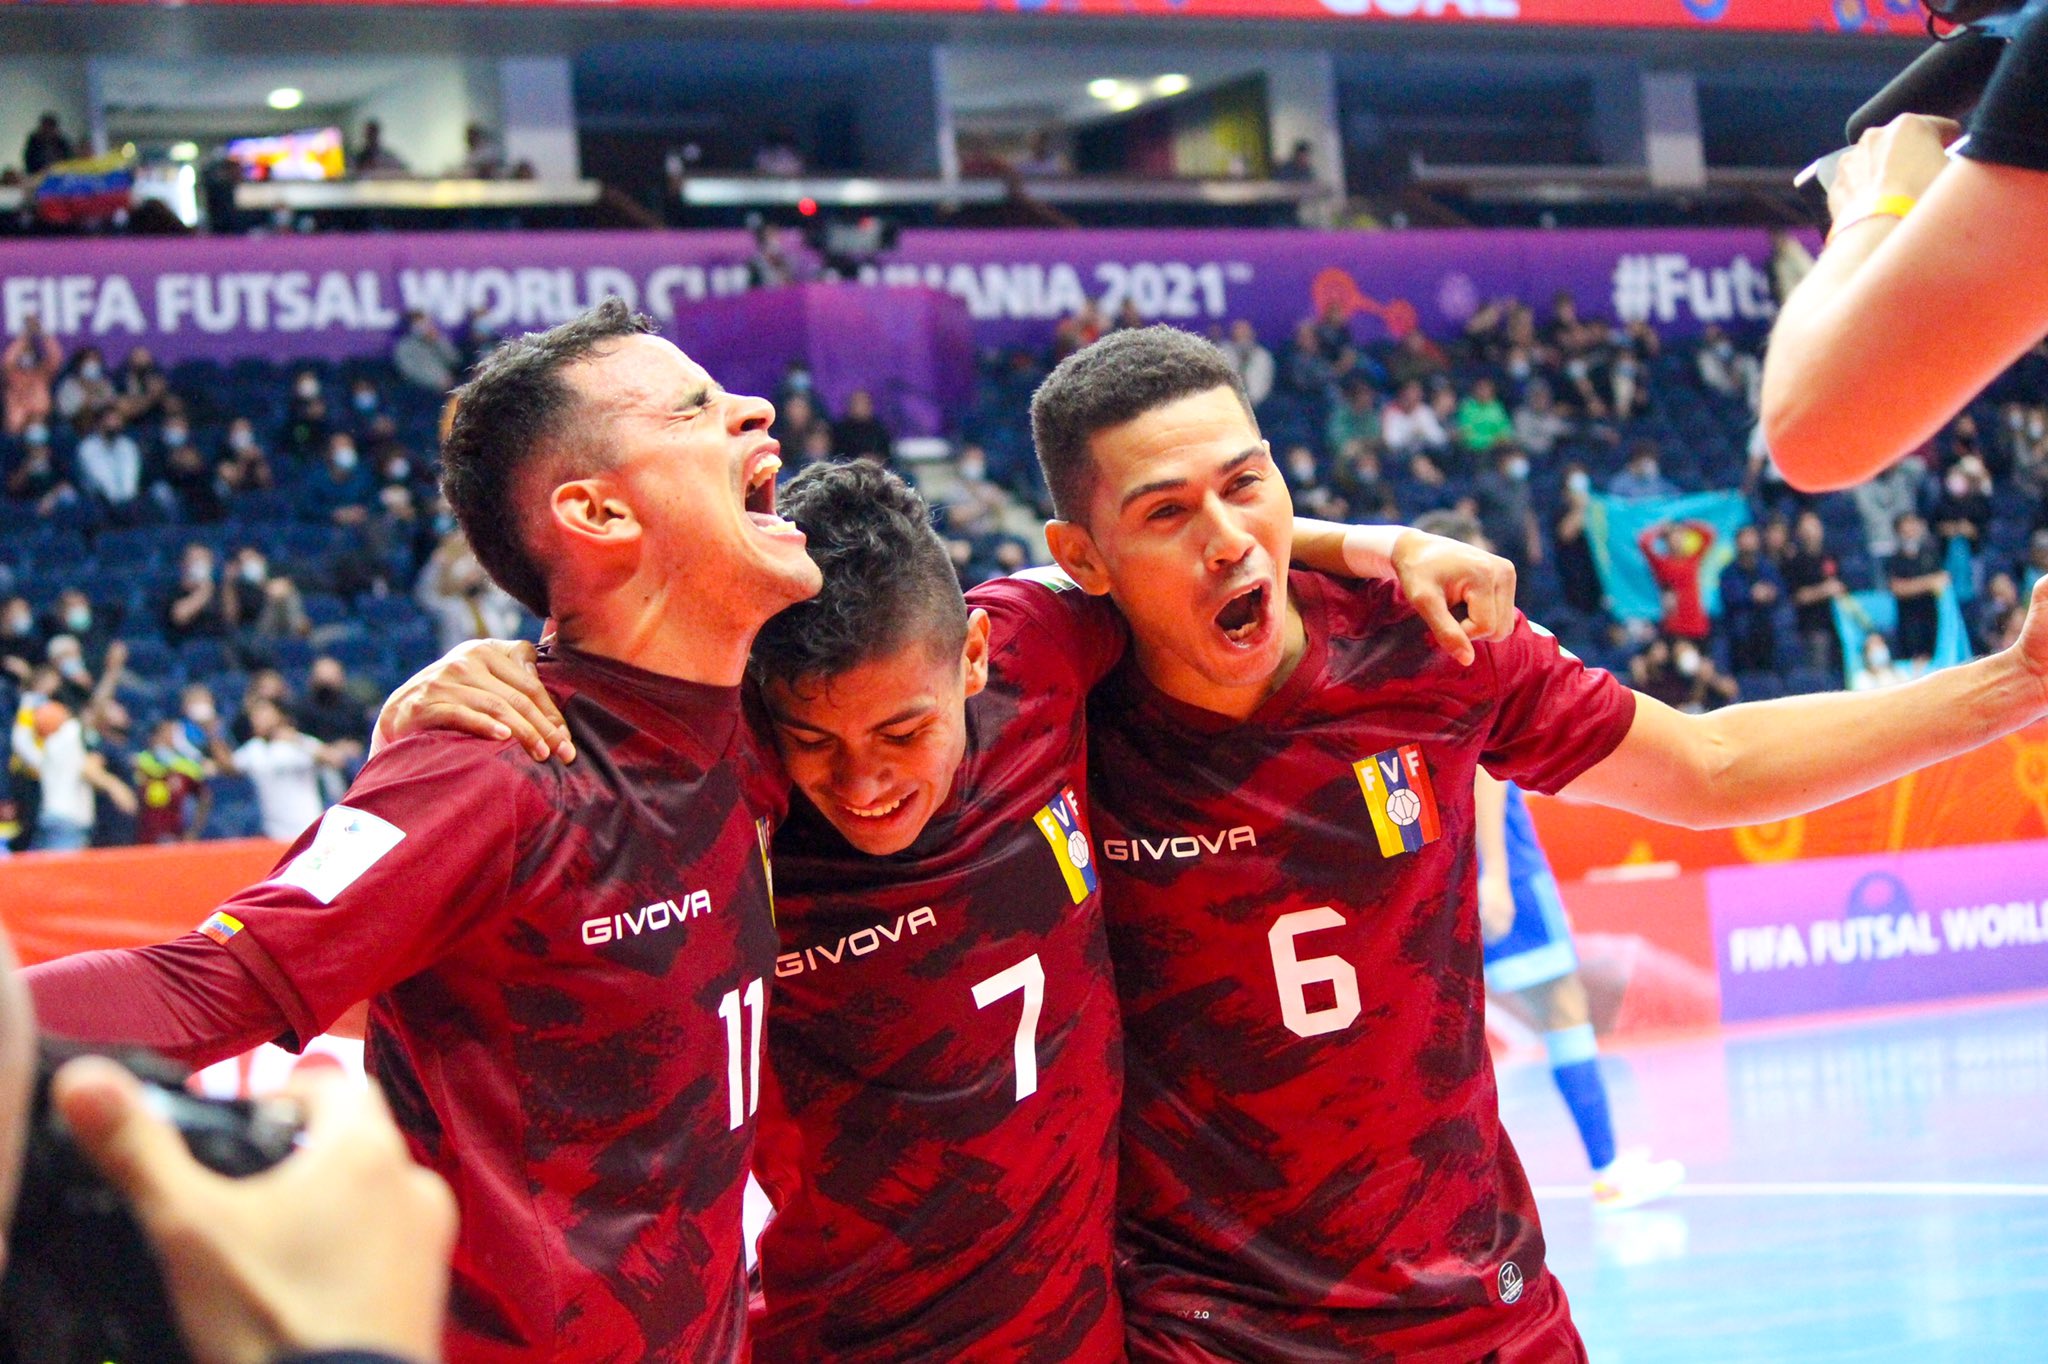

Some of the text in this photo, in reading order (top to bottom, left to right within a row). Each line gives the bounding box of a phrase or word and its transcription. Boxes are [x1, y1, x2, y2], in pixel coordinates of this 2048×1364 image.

[4, 274, 147, 335] FIFA
[156, 270, 398, 333] FUTSAL
[1360, 750, 1420, 792] FVF
[1041, 789, 1080, 842] FVF
[1103, 825, 1257, 861] GIVOVA
[581, 889, 712, 945] GIVOVA
[774, 906, 937, 978] GIVOVA
[1729, 923, 1808, 975] FIFA
[1809, 911, 1940, 967] FUTSAL
[1268, 906, 1362, 1038] 6
[718, 977, 763, 1131] 11
[971, 953, 1046, 1102] 7
